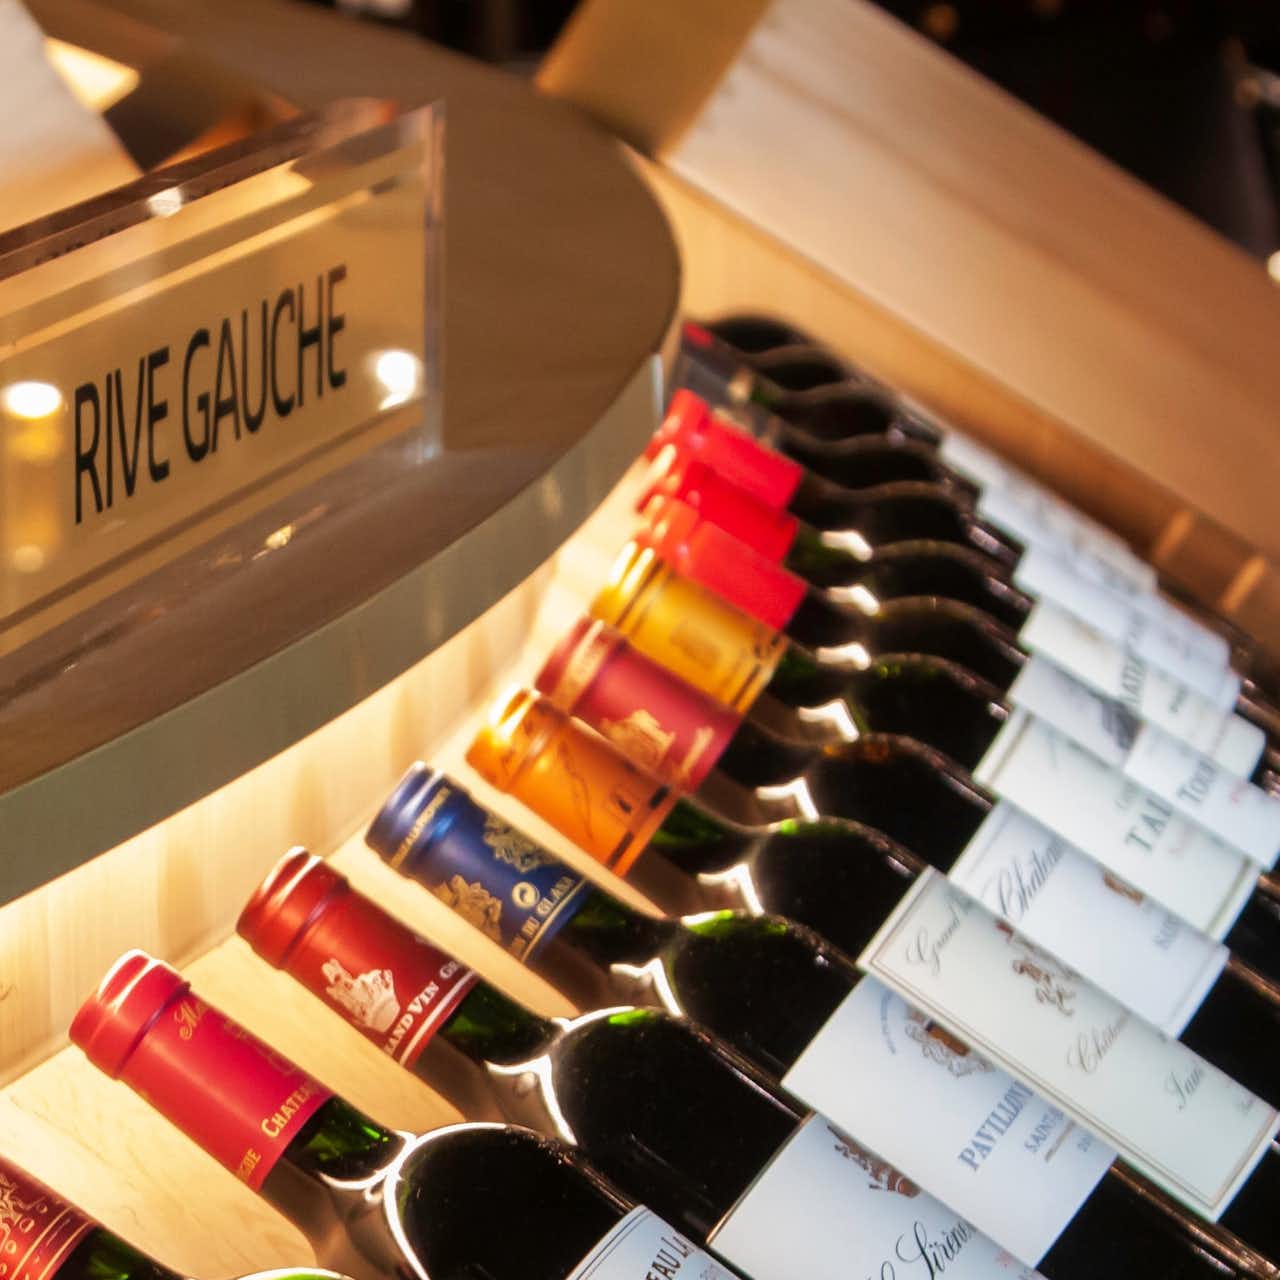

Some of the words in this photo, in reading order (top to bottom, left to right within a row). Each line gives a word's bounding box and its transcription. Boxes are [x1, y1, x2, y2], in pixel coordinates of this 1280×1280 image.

[74, 345, 170, 524] RIVE
[182, 264, 347, 463] GAUCHE
[408, 982, 439, 1014] VIN
